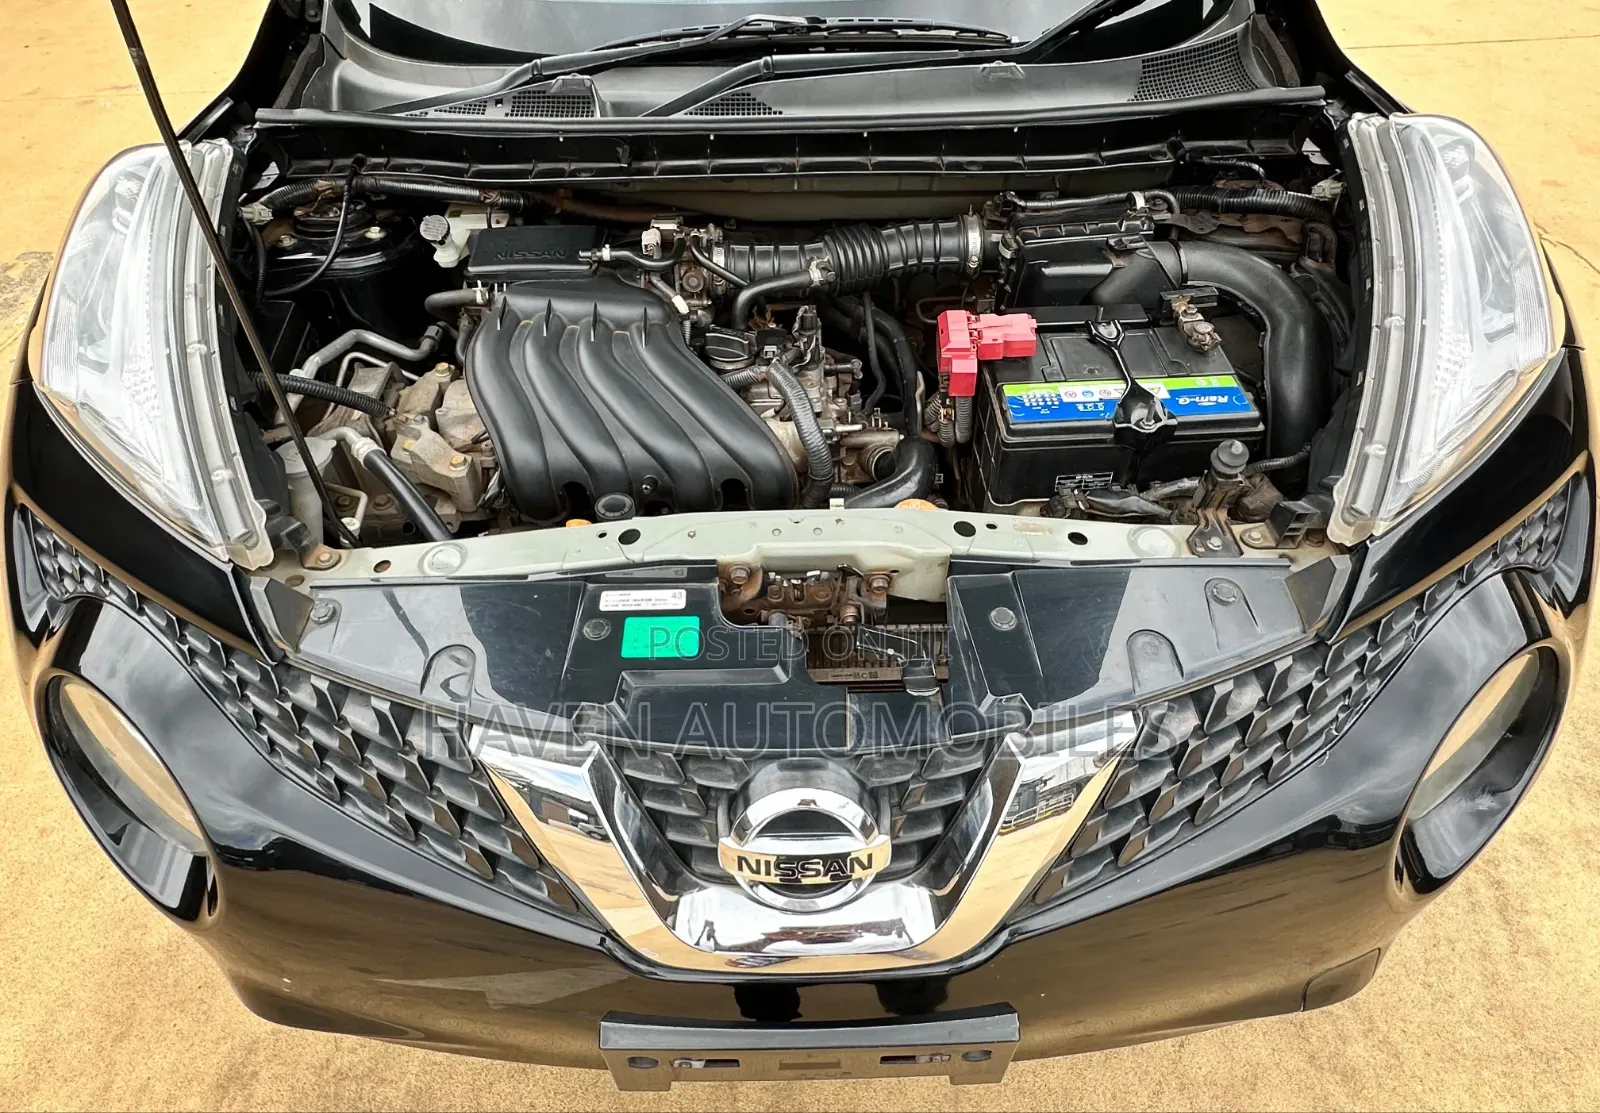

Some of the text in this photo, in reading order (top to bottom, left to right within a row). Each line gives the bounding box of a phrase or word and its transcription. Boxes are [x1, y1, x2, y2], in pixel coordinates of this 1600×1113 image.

[494, 250, 566, 260] NISSAN
[671, 591, 683, 600] 43
[737, 853, 873, 878] NISSAN
